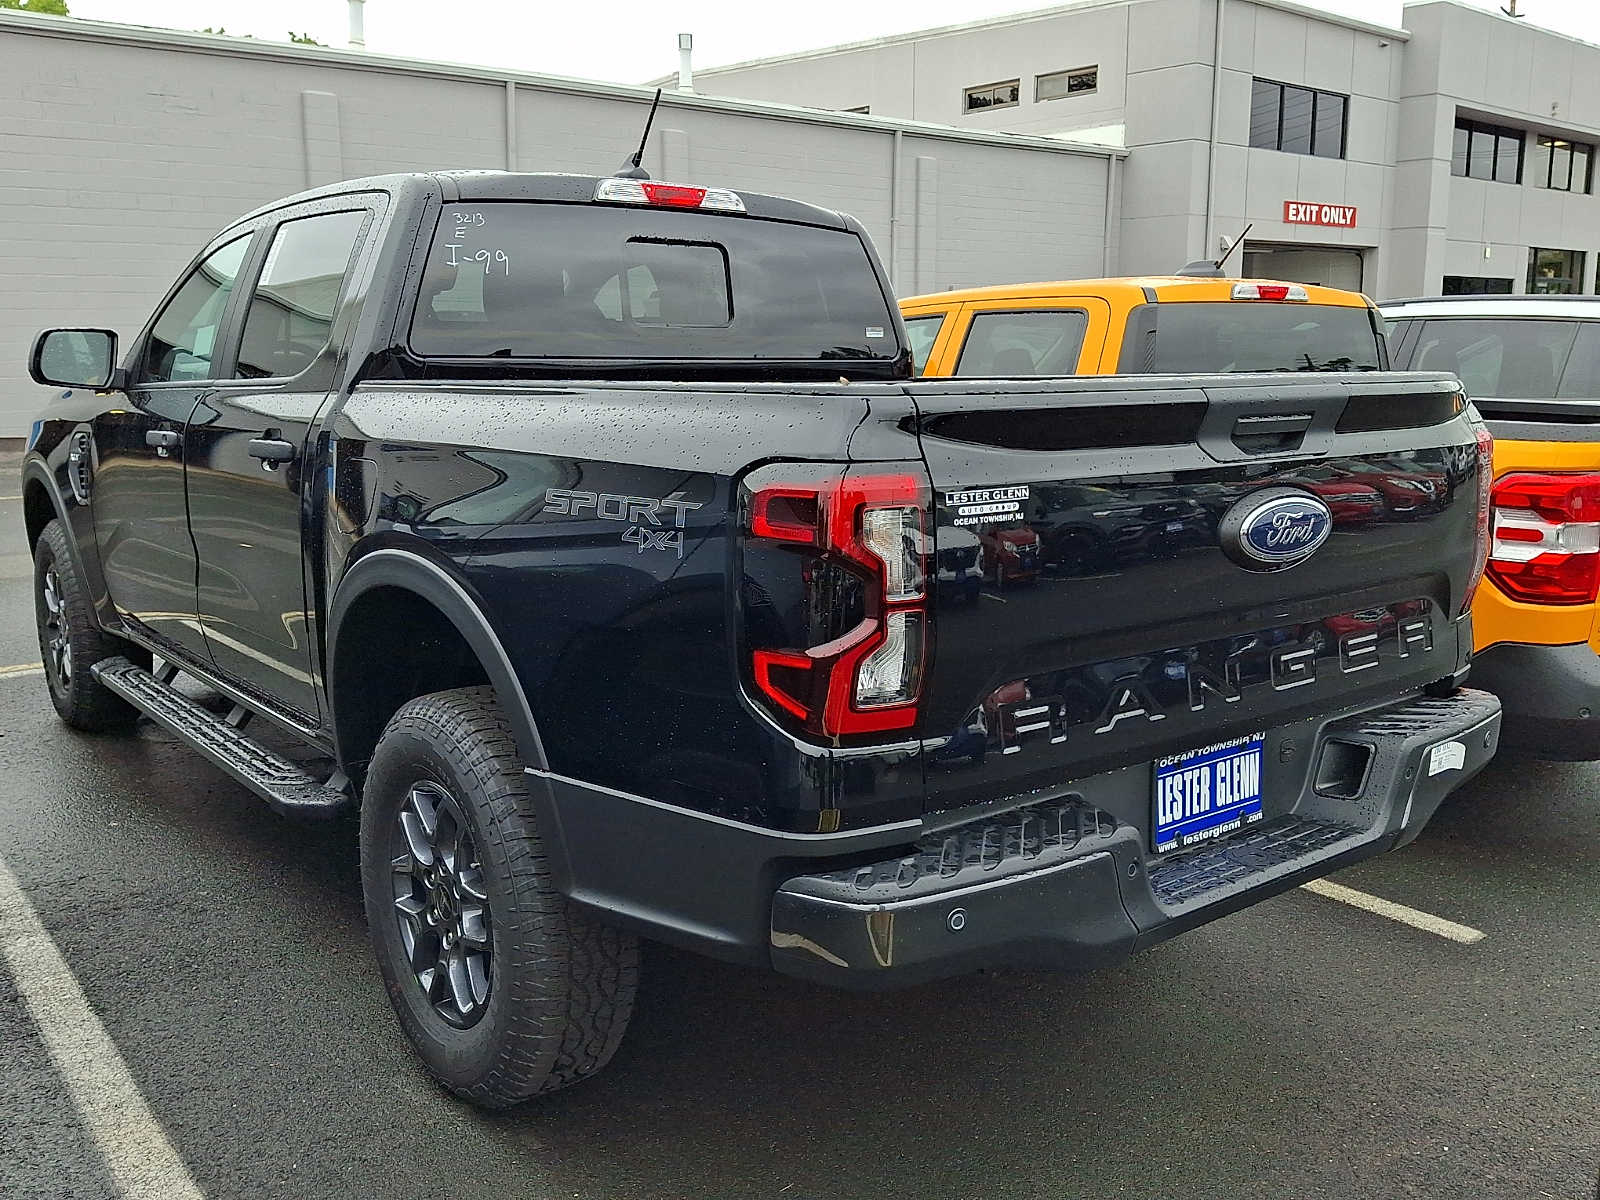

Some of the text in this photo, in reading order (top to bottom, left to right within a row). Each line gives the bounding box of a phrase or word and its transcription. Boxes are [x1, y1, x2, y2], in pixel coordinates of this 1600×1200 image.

[453, 212, 485, 227] 3213
[1288, 203, 1353, 225] EXIT ONLY
[542, 488, 704, 528] SPORT
[946, 487, 1029, 504] LESTER GLENN
[961, 503, 1017, 514] AUTO GROUP
[953, 516, 978, 526] OCEAN
[1015, 512, 1024, 520] NJ
[1266, 511, 1316, 547] Ford
[999, 612, 1434, 756] RANGER
[1160, 750, 1195, 768] OCEAN
[1252, 731, 1266, 742] NJ
[1157, 751, 1260, 826] LESTER GLENN
[1183, 820, 1241, 846] lesterglenn
